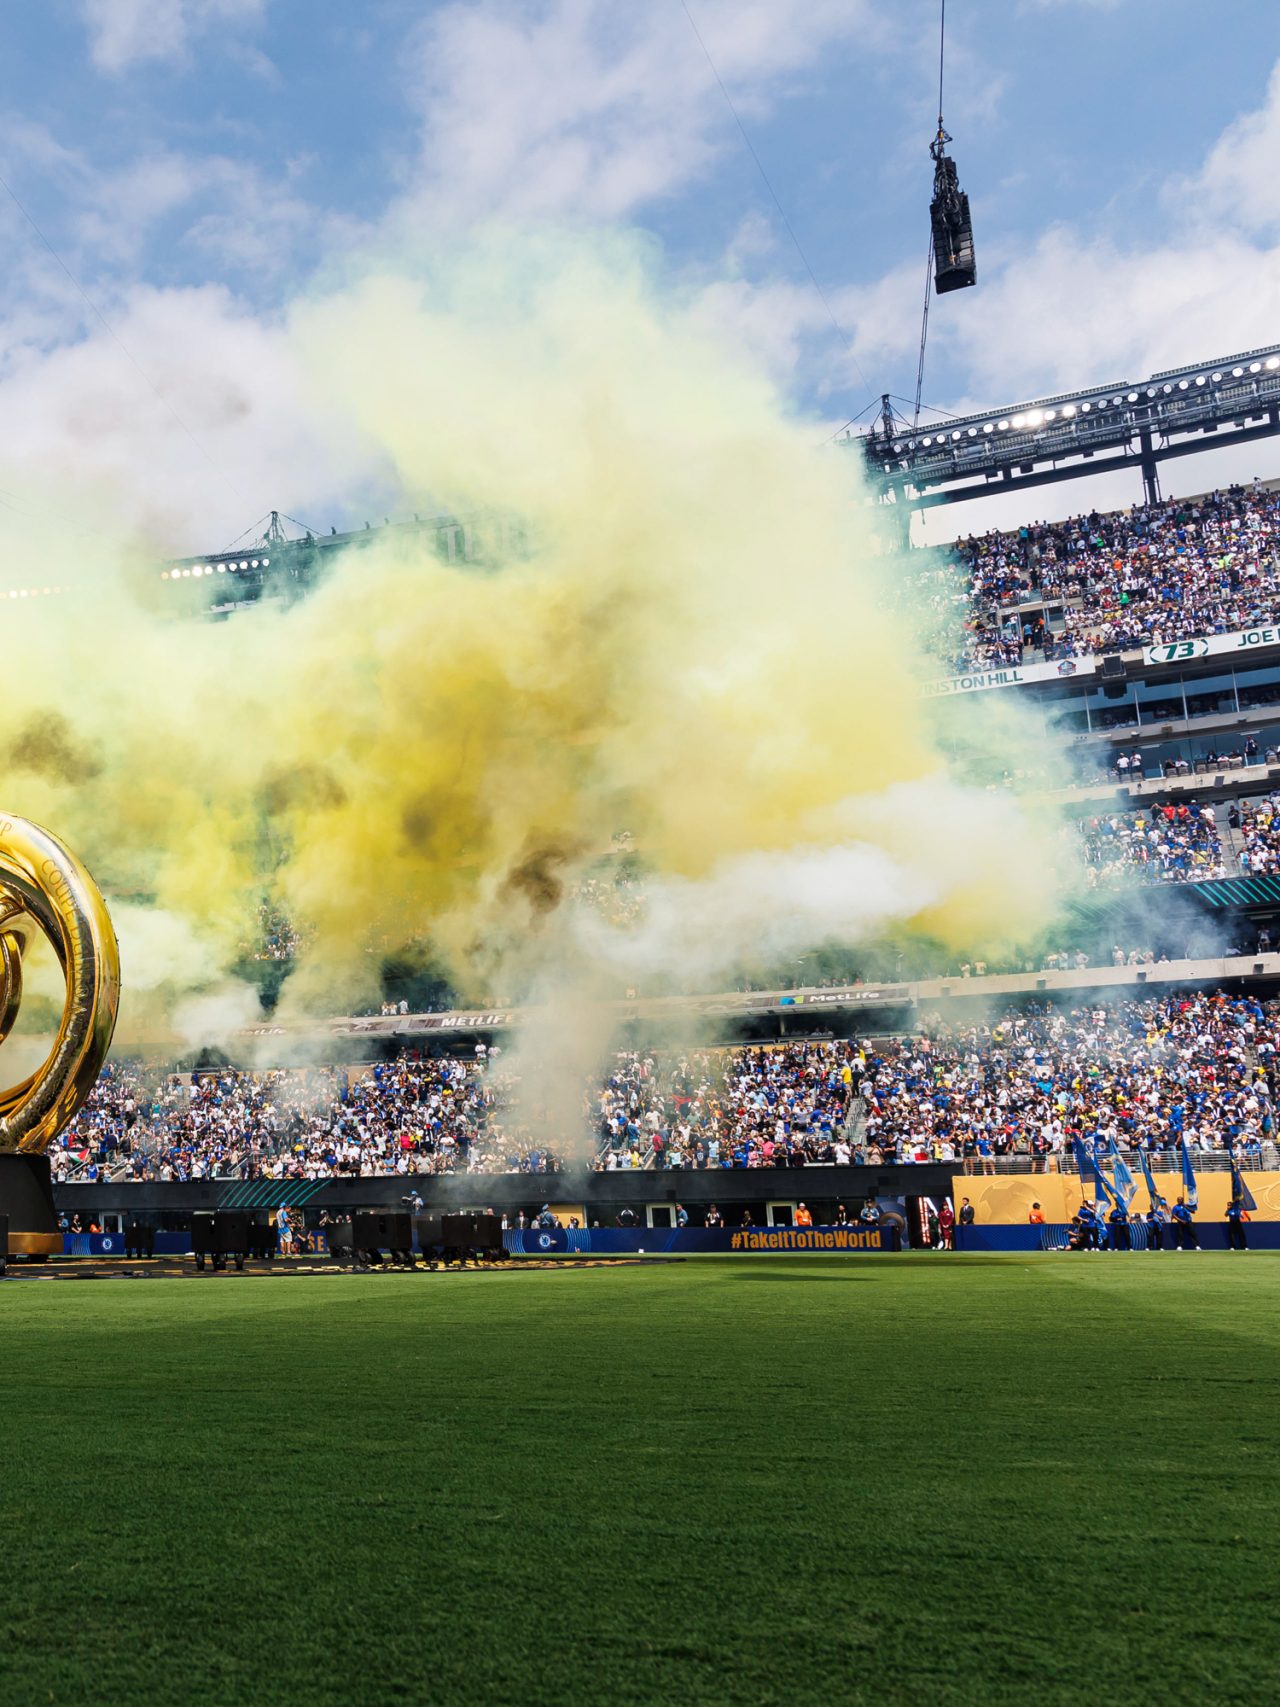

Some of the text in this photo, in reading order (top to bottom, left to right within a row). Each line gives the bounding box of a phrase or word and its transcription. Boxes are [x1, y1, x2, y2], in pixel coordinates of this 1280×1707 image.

[1162, 629, 1275, 660] 73 JOE
[987, 670, 1024, 686] HILL
[809, 990, 880, 1002] MetLife
[440, 1014, 513, 1027] METLIFE
[731, 1230, 882, 1249] #TakeItToTheWorld
